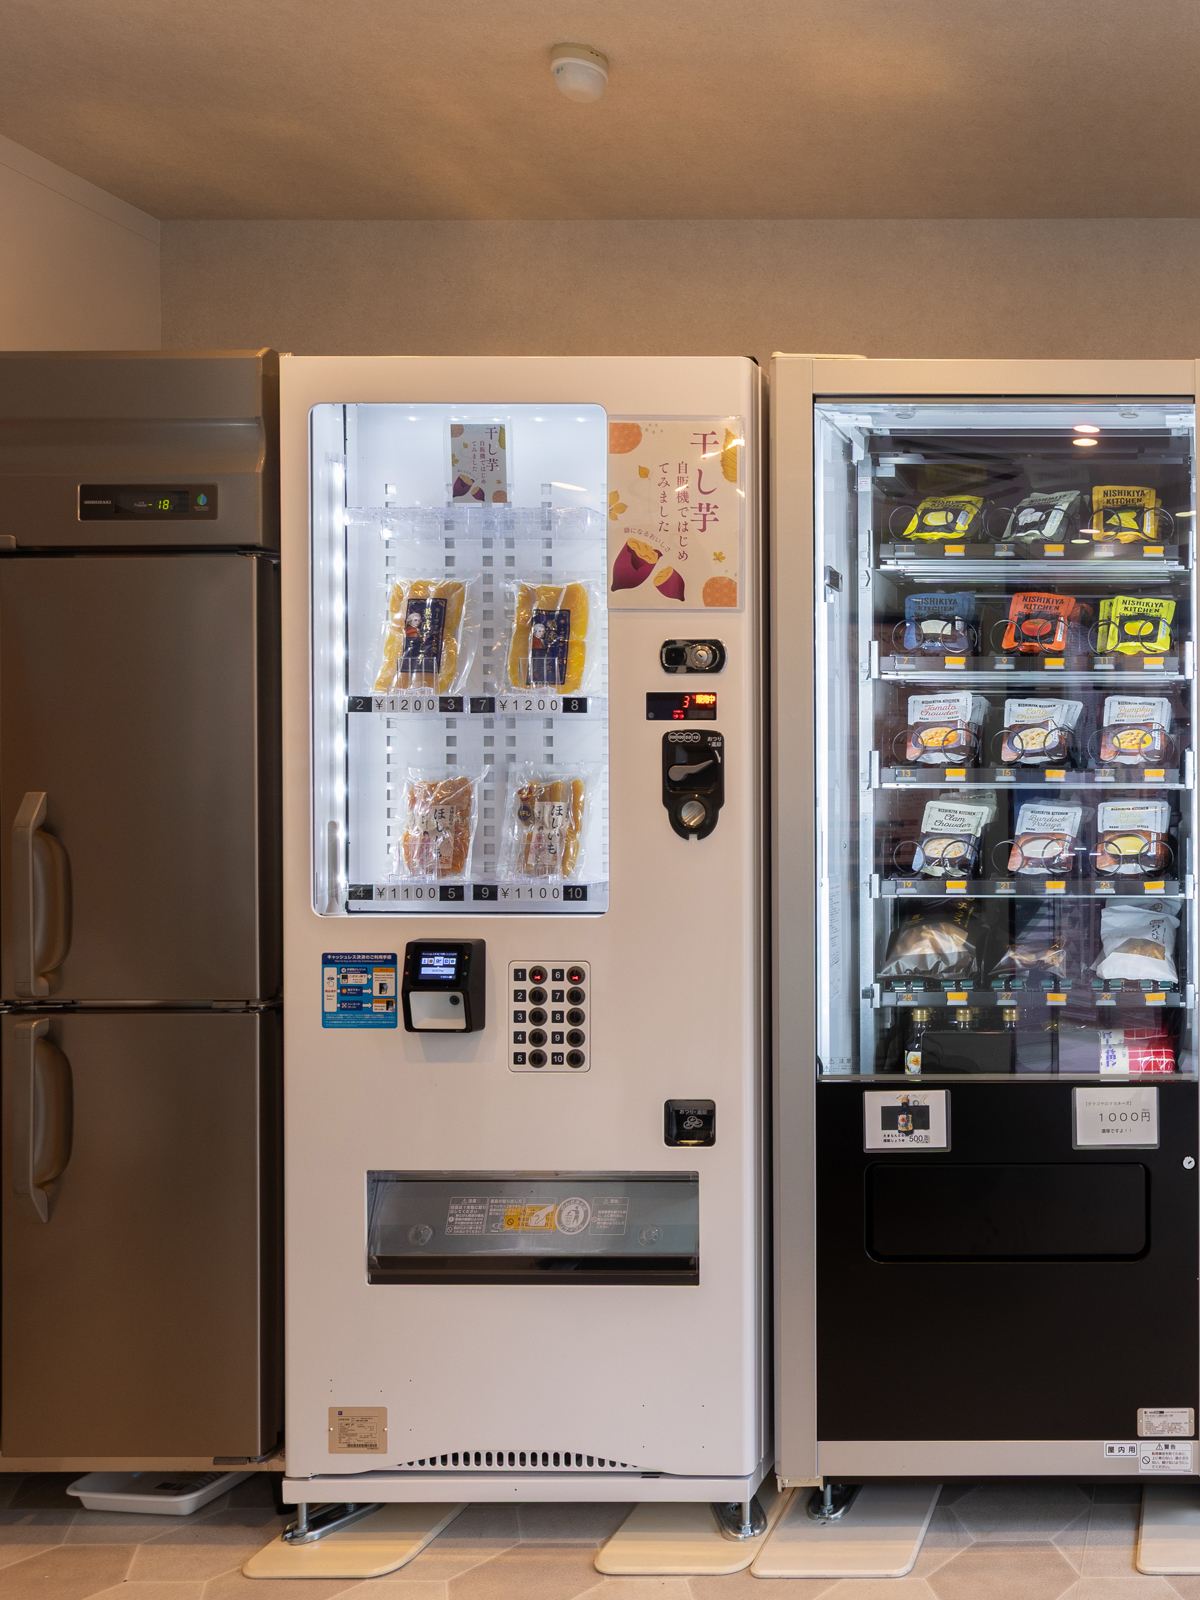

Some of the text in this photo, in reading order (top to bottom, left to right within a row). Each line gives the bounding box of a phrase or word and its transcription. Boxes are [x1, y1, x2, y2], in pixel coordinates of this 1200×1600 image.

[484, 426, 499, 472] 干し芋
[690, 430, 720, 533] 干し芋
[657, 462, 671, 533] てみました
[1103, 490, 1146, 498] NISHIKIYA
[1105, 497, 1143, 505] KITCHEN
[676, 461, 690, 562] 自販機ではじめ
[1022, 595, 1065, 605] NISHIKIYA
[1122, 599, 1165, 608] NISHIKIYA
[356, 699, 364, 710] 2
[374, 699, 436, 711] ¥1200
[447, 699, 455, 710] 3
[479, 700, 487, 711] 7
[499, 700, 559, 711] ¥1200
[571, 700, 579, 711] 8
[1118, 705, 1154, 713] Pumpkin
[920, 709, 959, 717] Chowder
[1025, 707, 1047, 715] Corn
[944, 813, 966, 822] Clam
[1028, 815, 1067, 823] Burdock
[933, 819, 973, 828] Chowder
[1031, 821, 1061, 830] Potage
[356, 888, 365, 898] 4
[376, 887, 437, 899] ¥1100
[447, 888, 456, 898] 5
[481, 888, 490, 898] 9
[501, 887, 560, 899] ¥1100
[567, 888, 583, 899] 10
[517, 971, 523, 979] 1
[555, 971, 561, 979] 6
[517, 992, 523, 1000] 2
[555, 992, 561, 1000] 7
[517, 1013, 523, 1021] 3
[555, 1013, 561, 1021] 8
[517, 1034, 523, 1042] 4
[555, 1034, 561, 1042] 9
